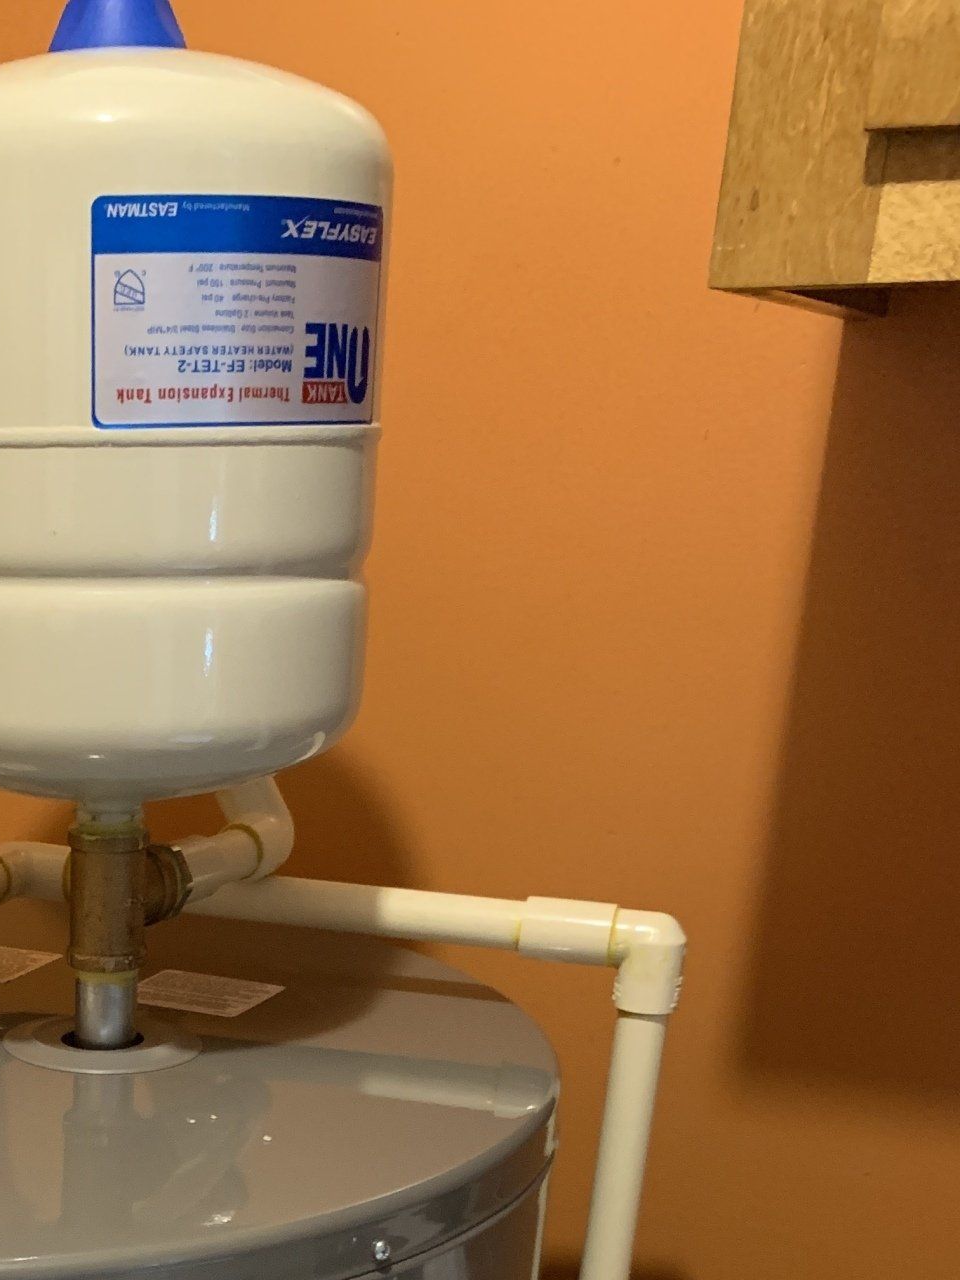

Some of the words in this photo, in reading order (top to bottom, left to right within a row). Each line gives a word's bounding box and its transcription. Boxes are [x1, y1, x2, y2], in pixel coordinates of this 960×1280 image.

[106, 202, 178, 218] EASTMAN
[281, 215, 378, 245] EASYFLEX
[124, 344, 161, 357] TANK)
[163, 345, 209, 356] SAFETY
[211, 345, 255, 356] HEATER
[257, 345, 294, 356] (WATER
[177, 359, 246, 373] EF-TET-2
[249, 359, 292, 373] Model:
[116, 387, 152, 404] Tank
[158, 383, 235, 403] Expansion
[238, 386, 290, 402] Thermal
[306, 383, 347, 403] TANK
